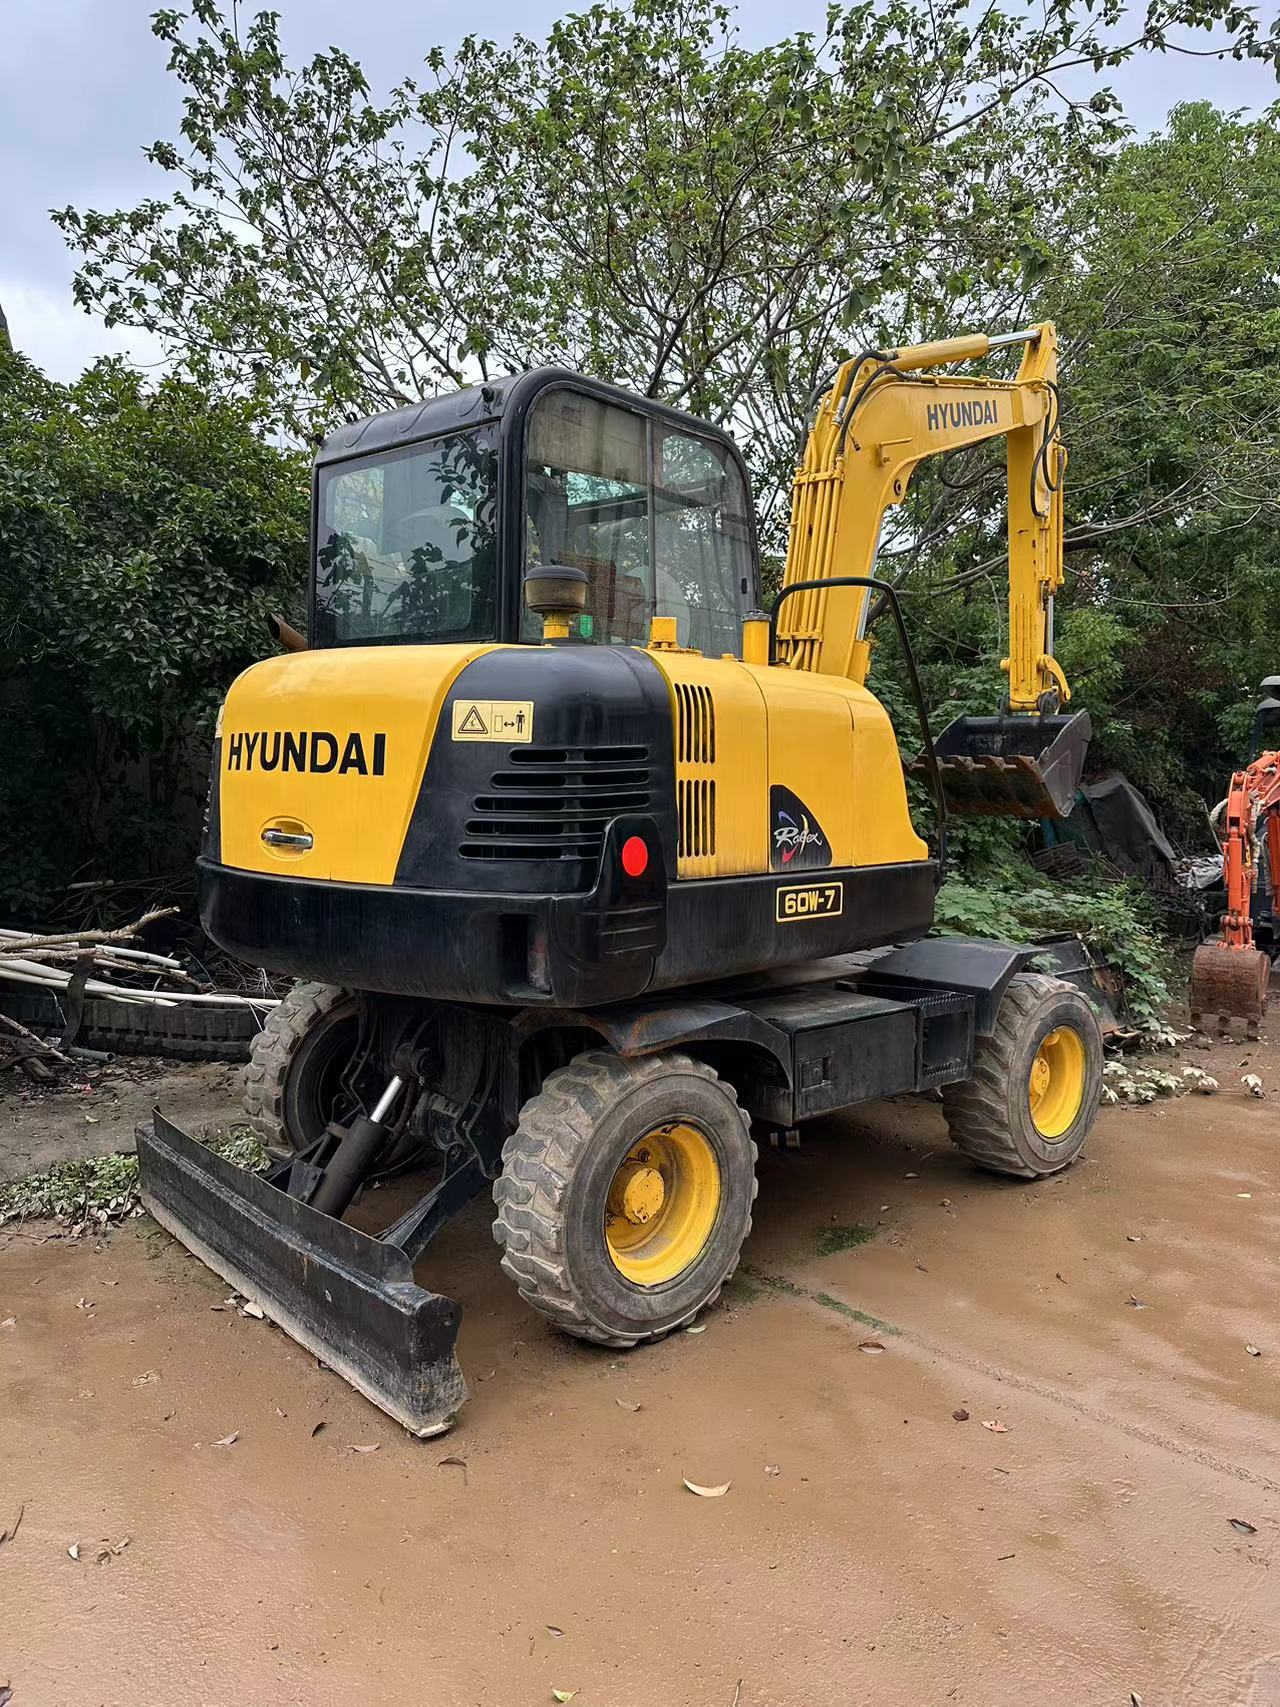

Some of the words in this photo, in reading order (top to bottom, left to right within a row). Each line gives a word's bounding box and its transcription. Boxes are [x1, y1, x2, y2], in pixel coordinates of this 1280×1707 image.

[927, 401, 997, 430] HYUNDAI
[228, 732, 386, 776] HYUNDAI
[785, 890, 835, 913] 60W-7
